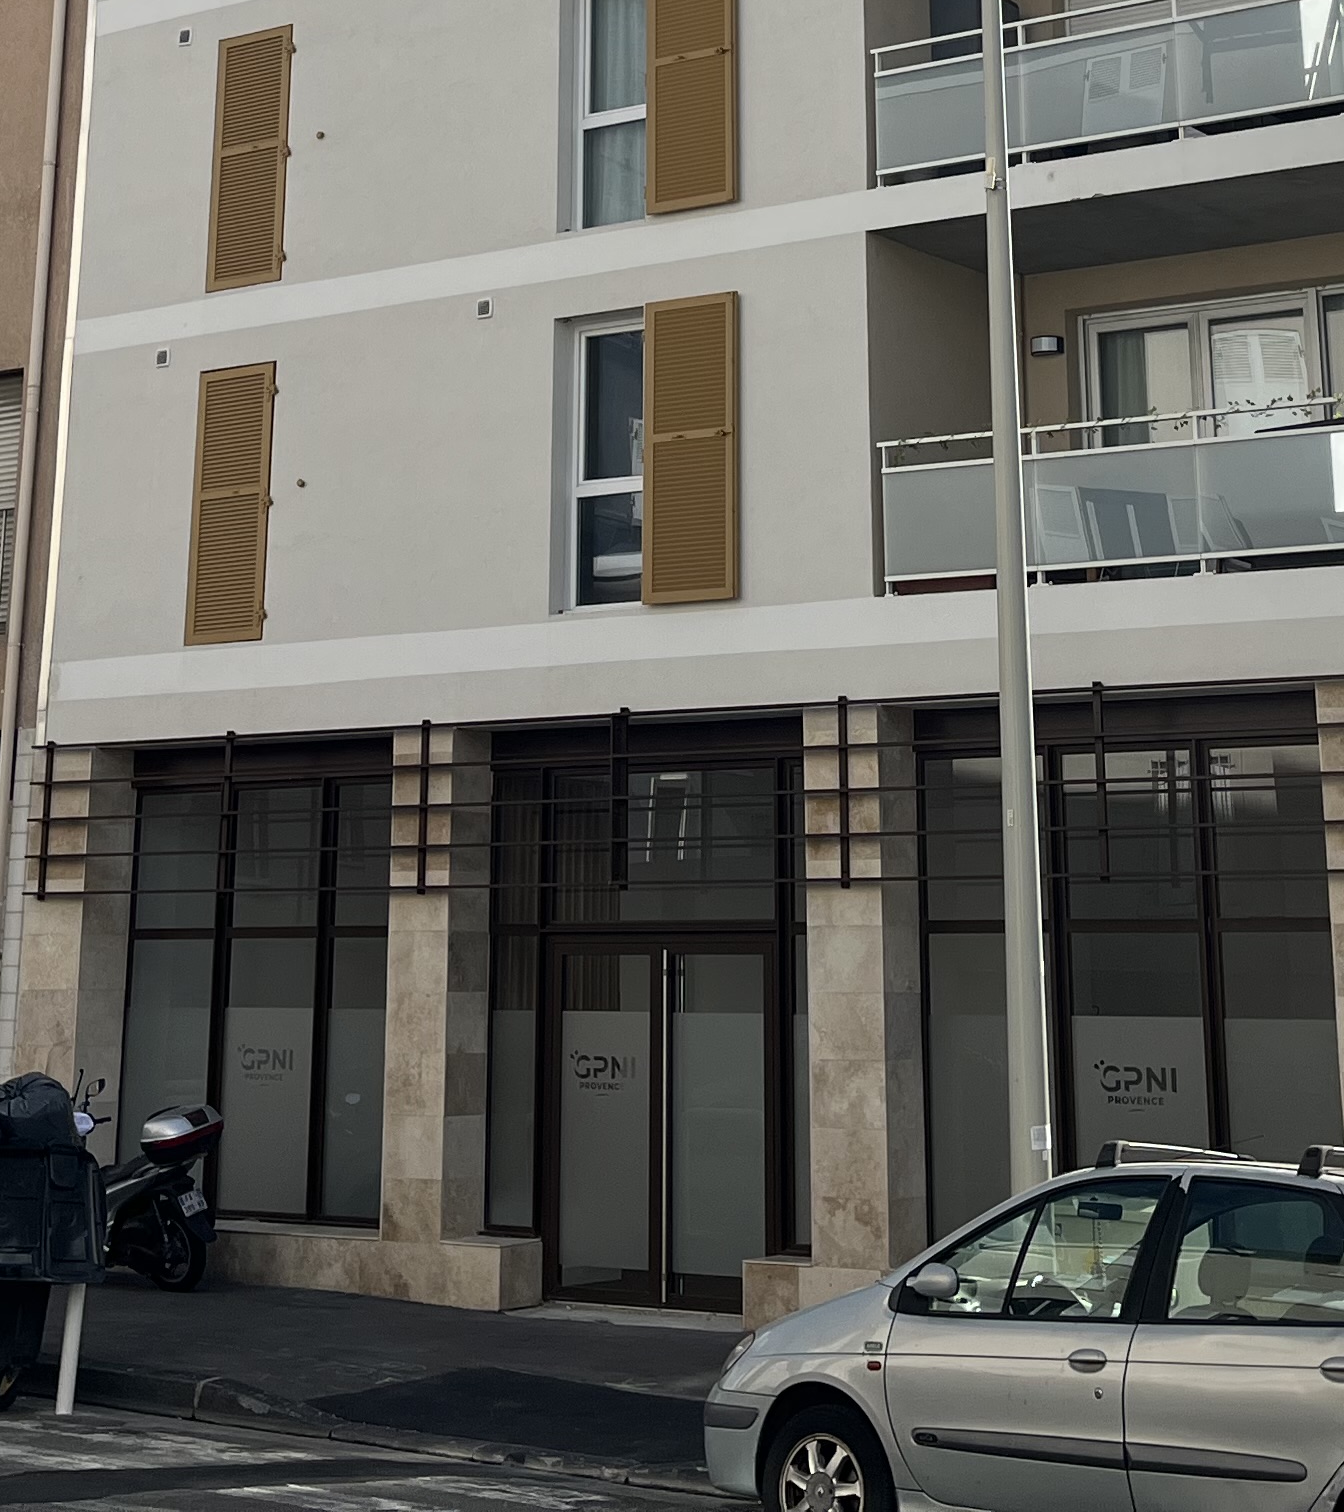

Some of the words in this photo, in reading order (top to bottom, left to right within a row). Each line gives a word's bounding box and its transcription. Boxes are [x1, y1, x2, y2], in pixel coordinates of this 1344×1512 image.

[240, 1046, 294, 1071] GPNI
[574, 1054, 636, 1079] GPNI
[1099, 1065, 1178, 1093] GPNI
[1107, 1095, 1165, 1105] PROVENCE
